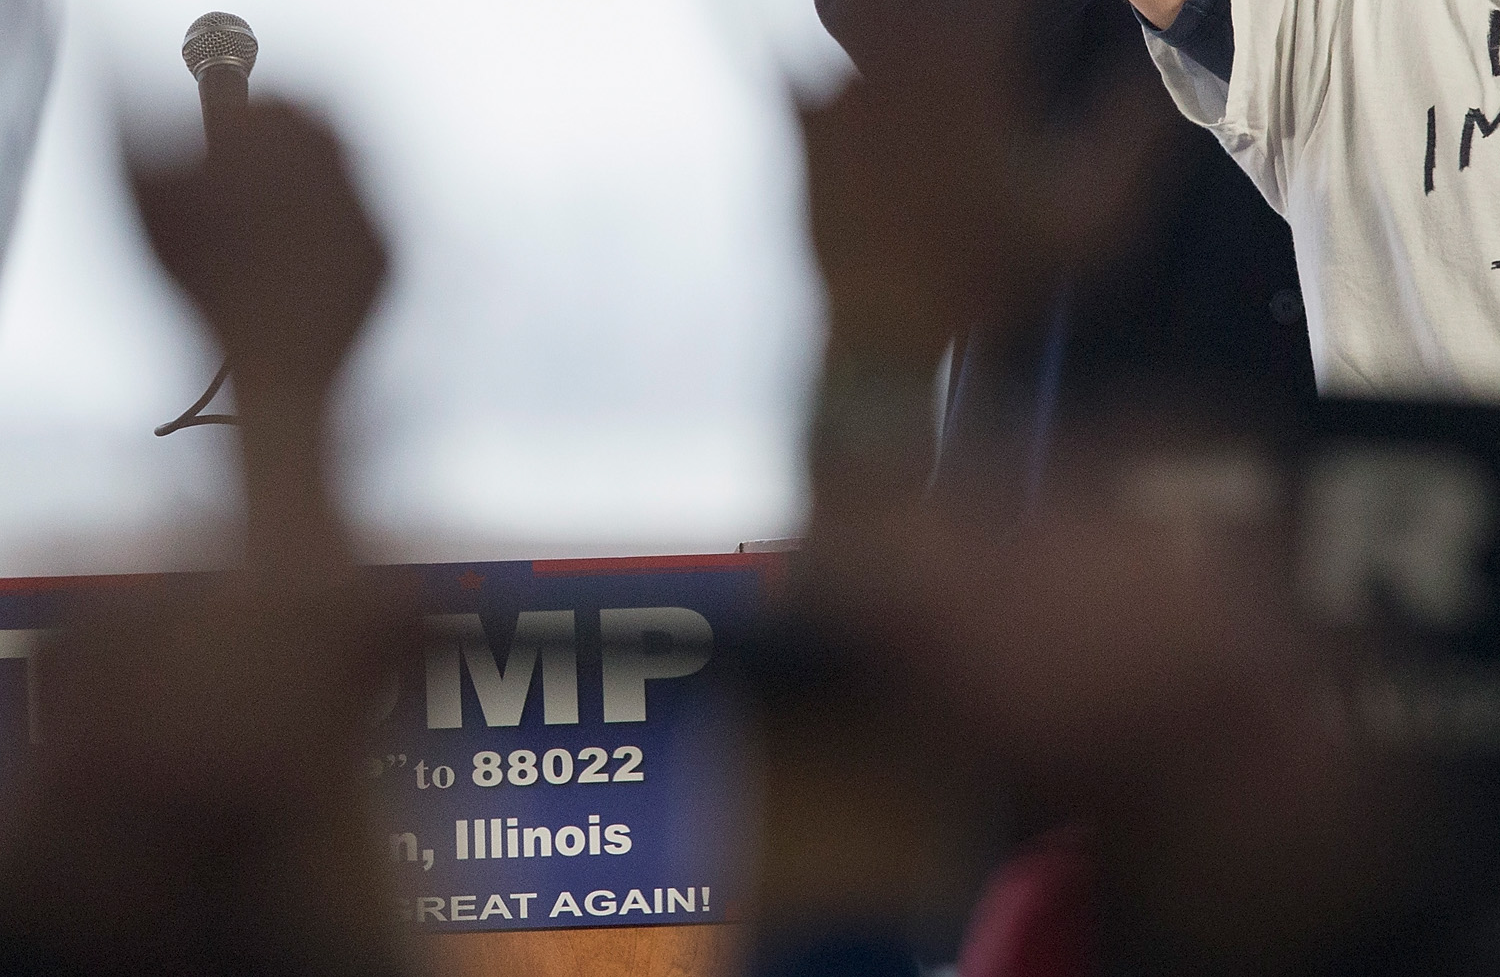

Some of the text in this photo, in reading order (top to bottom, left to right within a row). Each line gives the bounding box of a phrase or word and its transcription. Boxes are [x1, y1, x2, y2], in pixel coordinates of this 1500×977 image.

[412, 757, 456, 790] to
[471, 744, 646, 788] 88022
[454, 813, 634, 861] Illinois
[548, 885, 712, 918] AGAIN!
